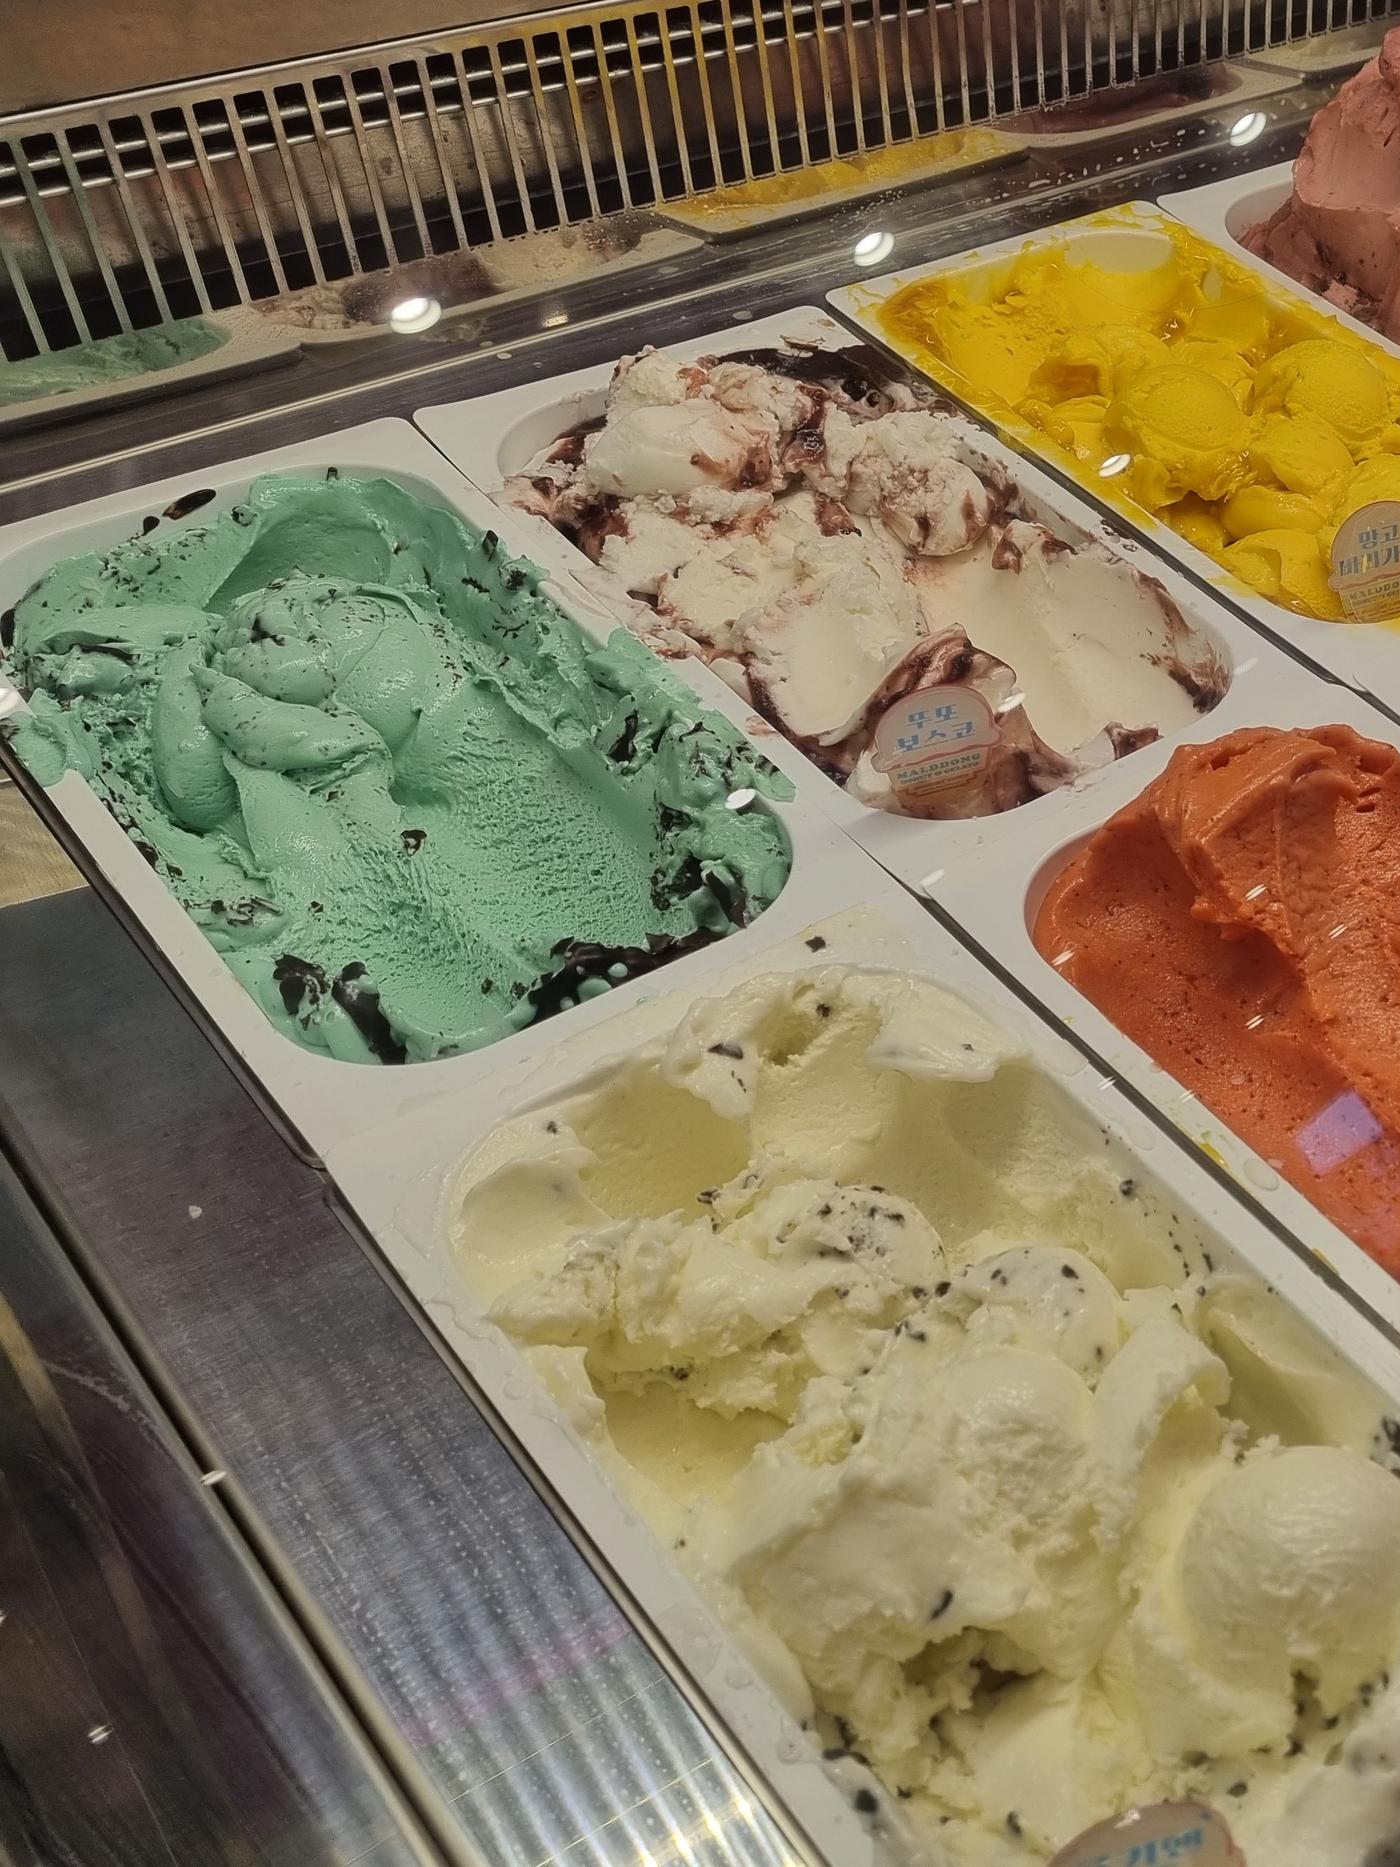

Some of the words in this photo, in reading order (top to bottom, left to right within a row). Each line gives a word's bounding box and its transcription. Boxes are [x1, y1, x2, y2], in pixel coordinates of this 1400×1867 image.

[1358, 523, 1400, 550] 망고
[906, 703, 957, 730] 뚜또
[896, 721, 976, 753] 보스코
[897, 752, 980, 779] MALDDONG
